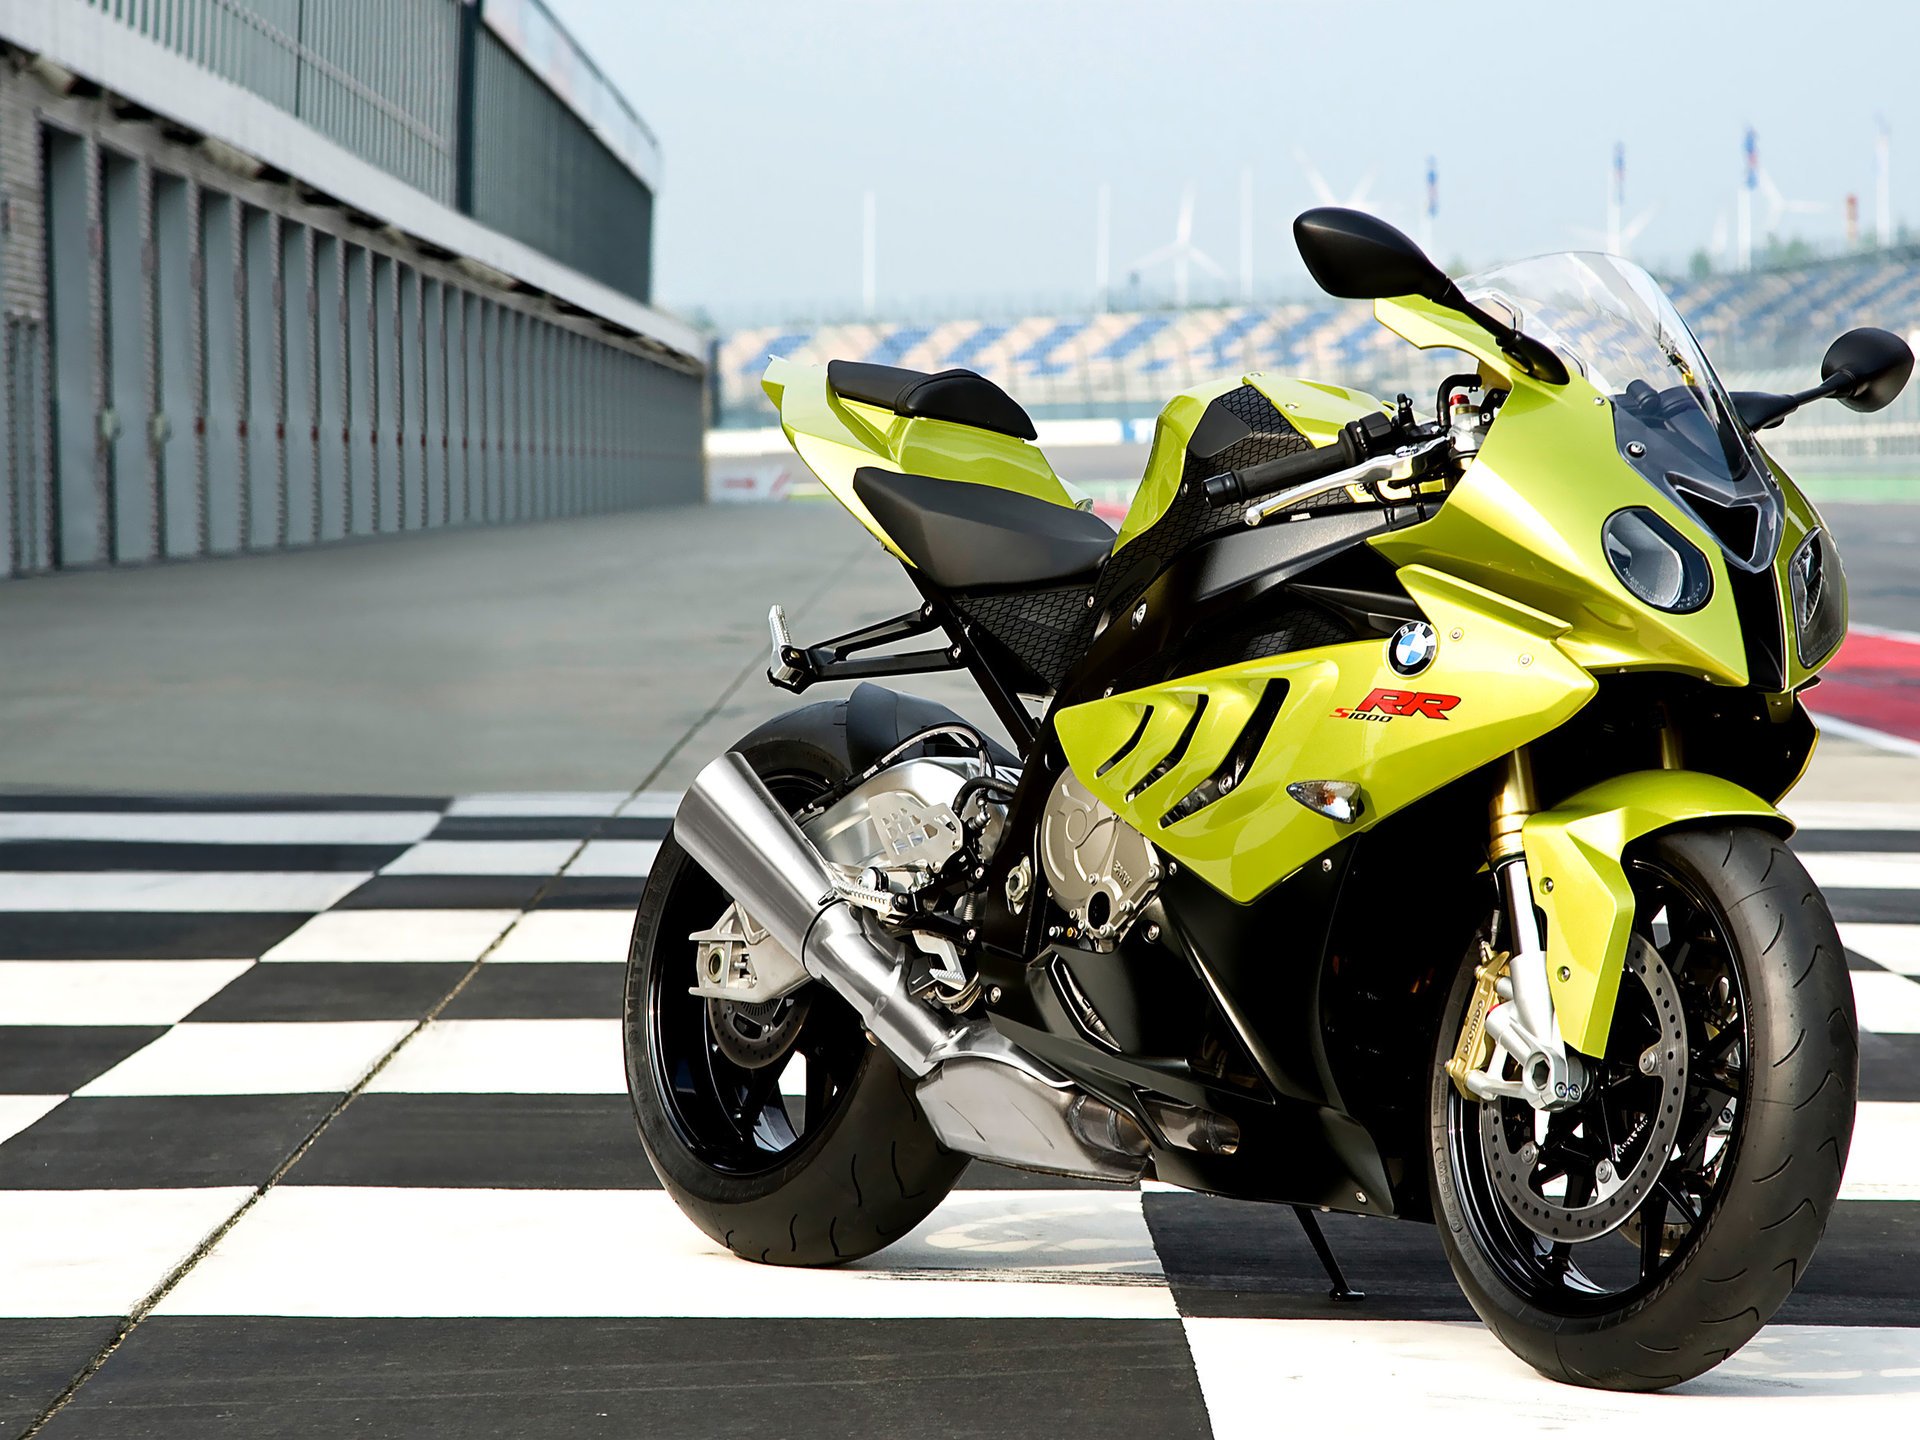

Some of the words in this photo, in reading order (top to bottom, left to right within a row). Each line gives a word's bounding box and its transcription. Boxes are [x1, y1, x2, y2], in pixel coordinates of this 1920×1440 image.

[1329, 707, 1393, 723] S1000
[1354, 687, 1462, 720] RR
[627, 866, 668, 1024] METZELER
